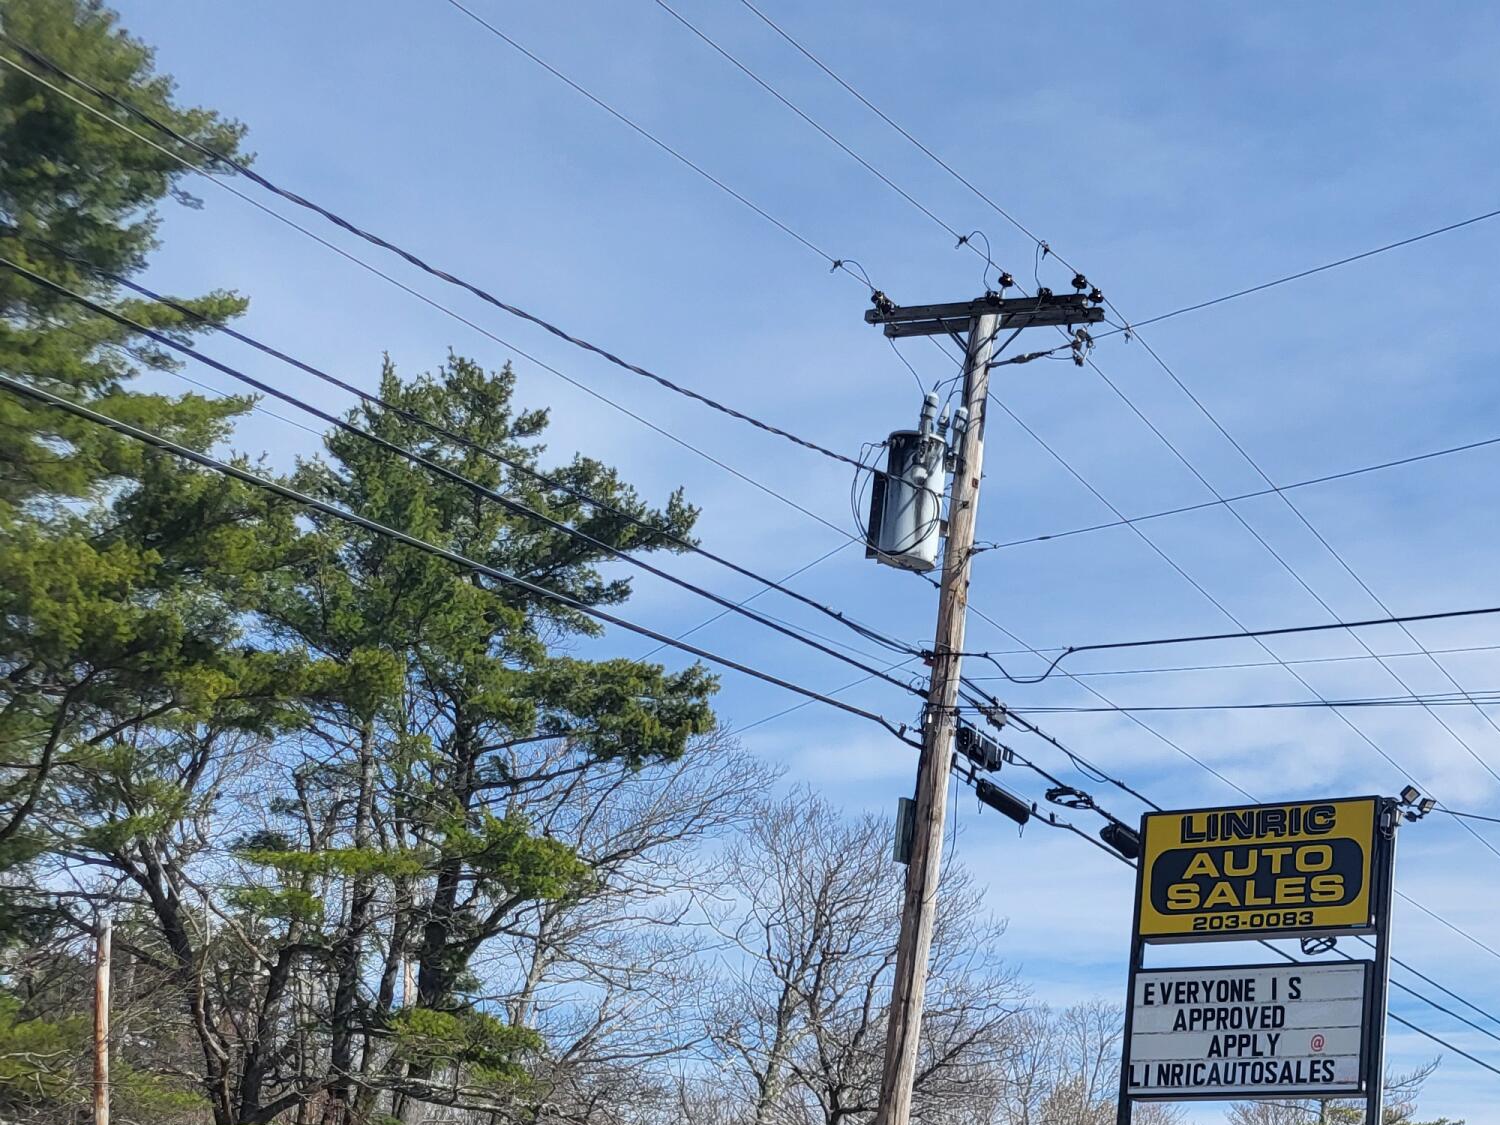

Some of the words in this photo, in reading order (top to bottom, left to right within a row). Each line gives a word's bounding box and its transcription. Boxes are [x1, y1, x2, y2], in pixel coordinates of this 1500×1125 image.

[1181, 805, 1336, 843] LINRIC
[1182, 844, 1333, 880] AUTO
[1166, 874, 1345, 910] SALES
[1193, 911, 1314, 931] 203-0083
[1143, 978, 1256, 1006] EVERYONE
[1172, 1005, 1286, 1032] APPROVED
[1207, 1033, 1281, 1058] APPLY
[1310, 1034, 1325, 1052] @
